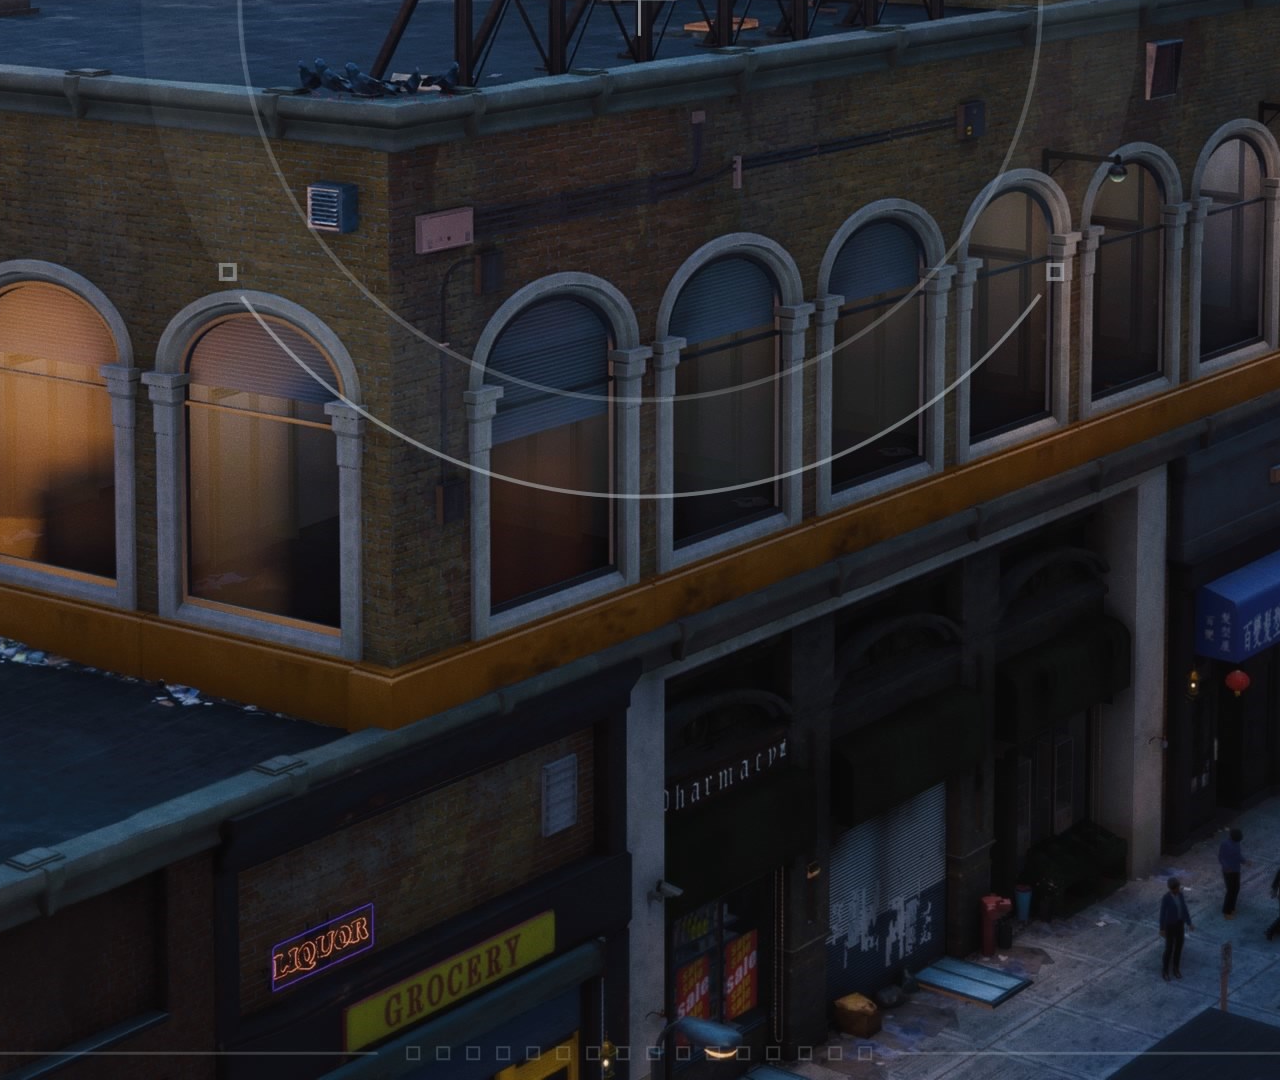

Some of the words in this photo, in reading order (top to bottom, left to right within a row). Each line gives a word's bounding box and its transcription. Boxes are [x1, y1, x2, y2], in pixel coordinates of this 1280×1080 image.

[272, 916, 370, 980] LIQUOR
[726, 949, 757, 994] sale
[384, 933, 522, 1028] GROCERY
